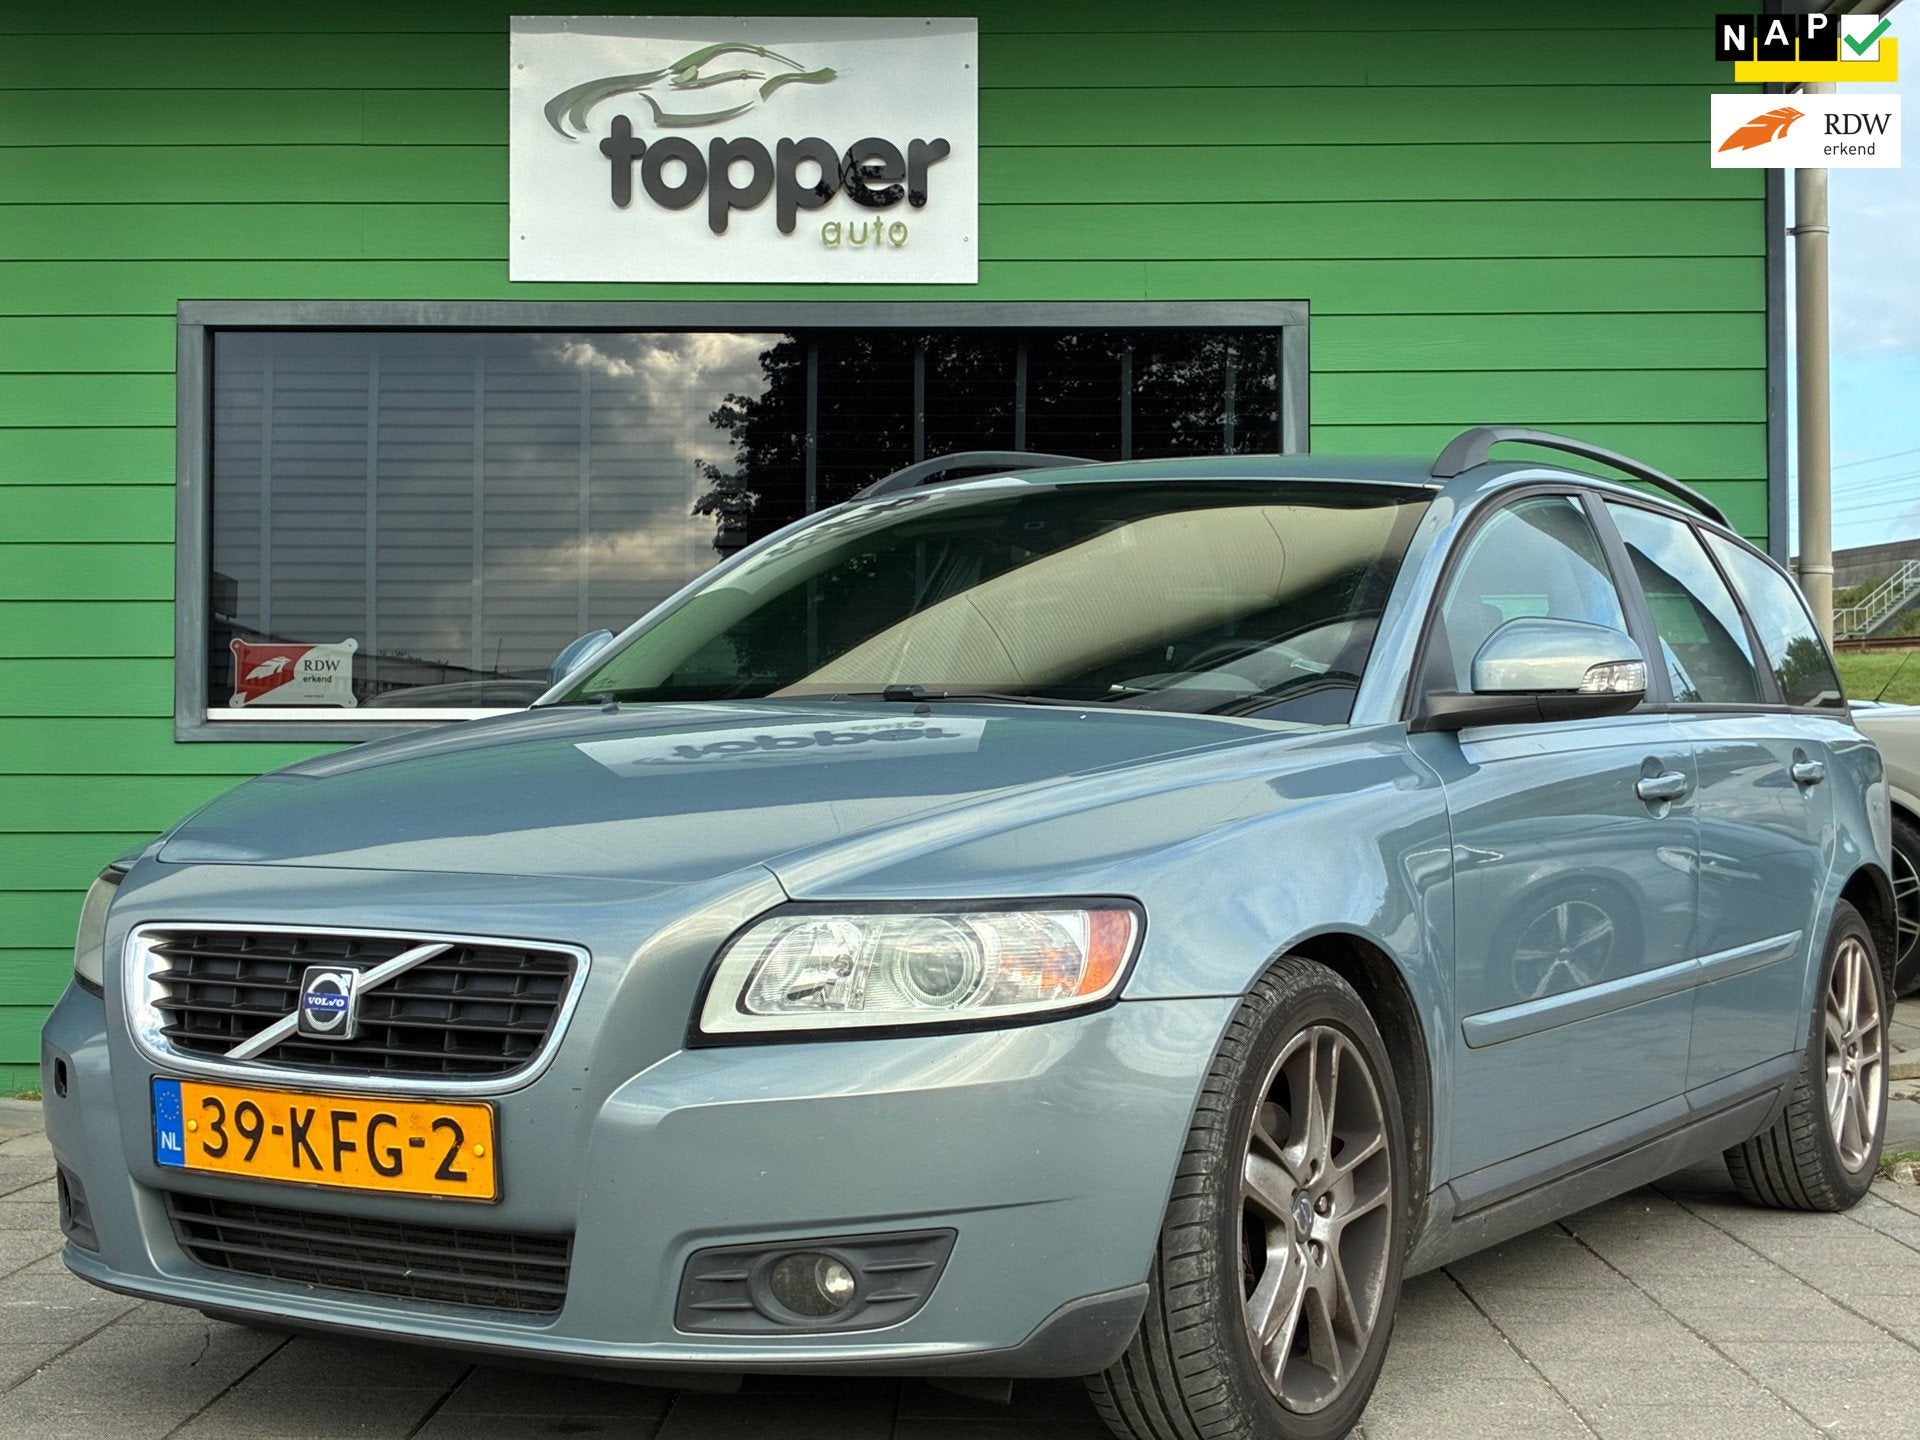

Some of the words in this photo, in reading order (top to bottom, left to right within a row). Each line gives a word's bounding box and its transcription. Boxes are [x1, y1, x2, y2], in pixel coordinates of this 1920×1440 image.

[599, 114, 951, 235] topper
[821, 215, 909, 248] auto
[303, 659, 340, 672] RDW
[302, 674, 332, 683] erkend
[307, 997, 345, 1007] VOLVO
[161, 1130, 181, 1152] NL
[201, 1096, 468, 1182] 39-KFG-2
